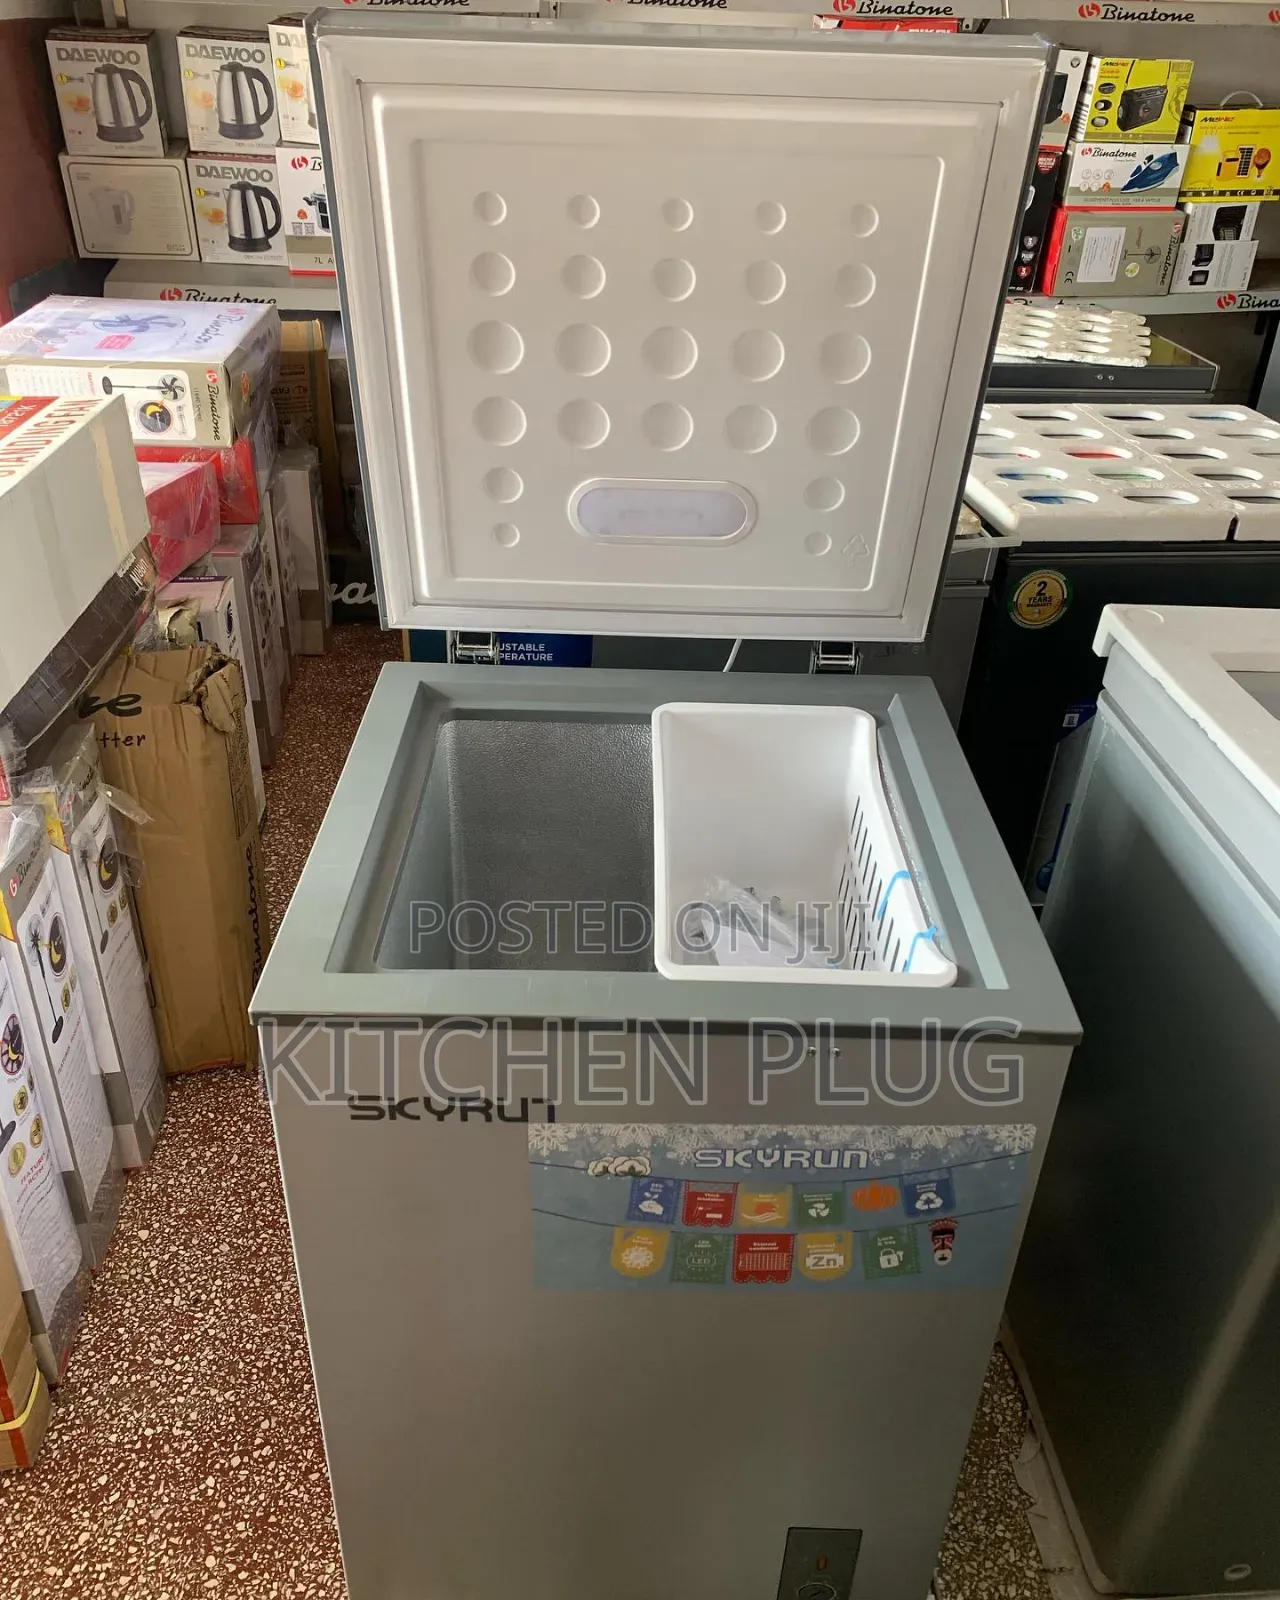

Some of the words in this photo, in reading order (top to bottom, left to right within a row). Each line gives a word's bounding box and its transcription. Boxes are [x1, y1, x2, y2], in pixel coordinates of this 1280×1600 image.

[856, 0, 954, 16] Binatone
[1101, 4, 1195, 22] Binatone
[55, 47, 141, 66] DAEWOO
[184, 43, 266, 64] DAEWOO
[1092, 147, 1137, 158] Binatone
[195, 165, 274, 183] DAEWOO
[314, 256, 324, 265] 7L
[1159, 235, 1180, 287] Binatone
[44, 399, 104, 419] FAN
[207, 384, 221, 441] Binatone
[1036, 581, 1048, 596] 2
[695, 1148, 868, 1169] SKYRUN
[811, 1256, 838, 1268] Zn
